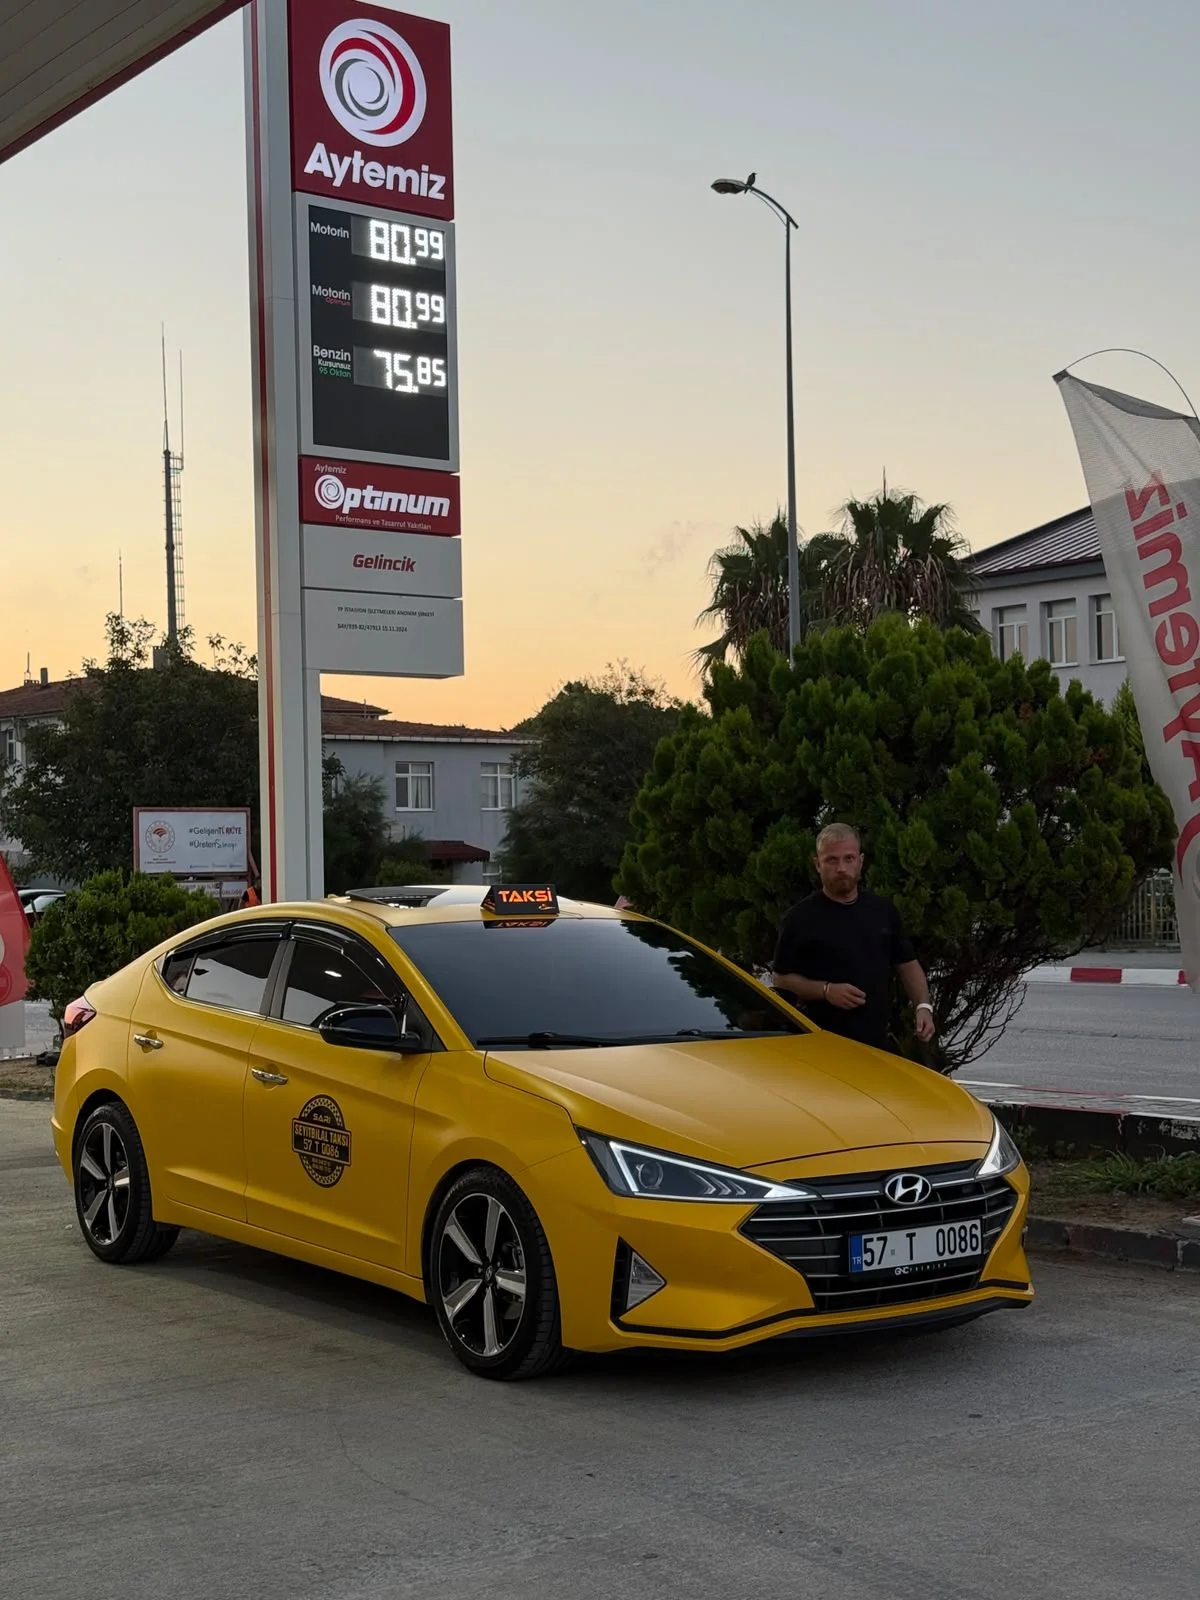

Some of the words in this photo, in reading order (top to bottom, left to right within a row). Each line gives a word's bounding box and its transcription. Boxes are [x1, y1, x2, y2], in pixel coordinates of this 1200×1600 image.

[303, 142, 446, 200] Aytemiz
[310, 222, 350, 239] Motorin
[369, 219, 444, 265] 80.99
[312, 284, 351, 301] Motorin
[370, 284, 445, 329] 80.99
[313, 344, 351, 362] Benzin
[373, 349, 446, 393] 75.85
[319, 366, 328, 375] 95
[330, 368, 351, 378] Oktan
[314, 463, 347, 474] Aytemiz
[314, 474, 450, 517] Optimum
[335, 514, 371, 525] Performans
[381, 519, 406, 528] Tasarruf
[352, 553, 416, 573] Gelincik
[498, 887, 553, 903] TAKSİ
[312, 1113, 332, 1124] SARI
[303, 1138, 313, 1151] 57
[314, 1142, 320, 1153] T
[321, 1143, 340, 1158] 0086
[852, 1256, 862, 1265] TR
[863, 1236, 888, 1267] 57
[905, 1232, 917, 1261] T
[936, 1224, 979, 1257] 0086
[894, 1266, 909, 1276] GNC
